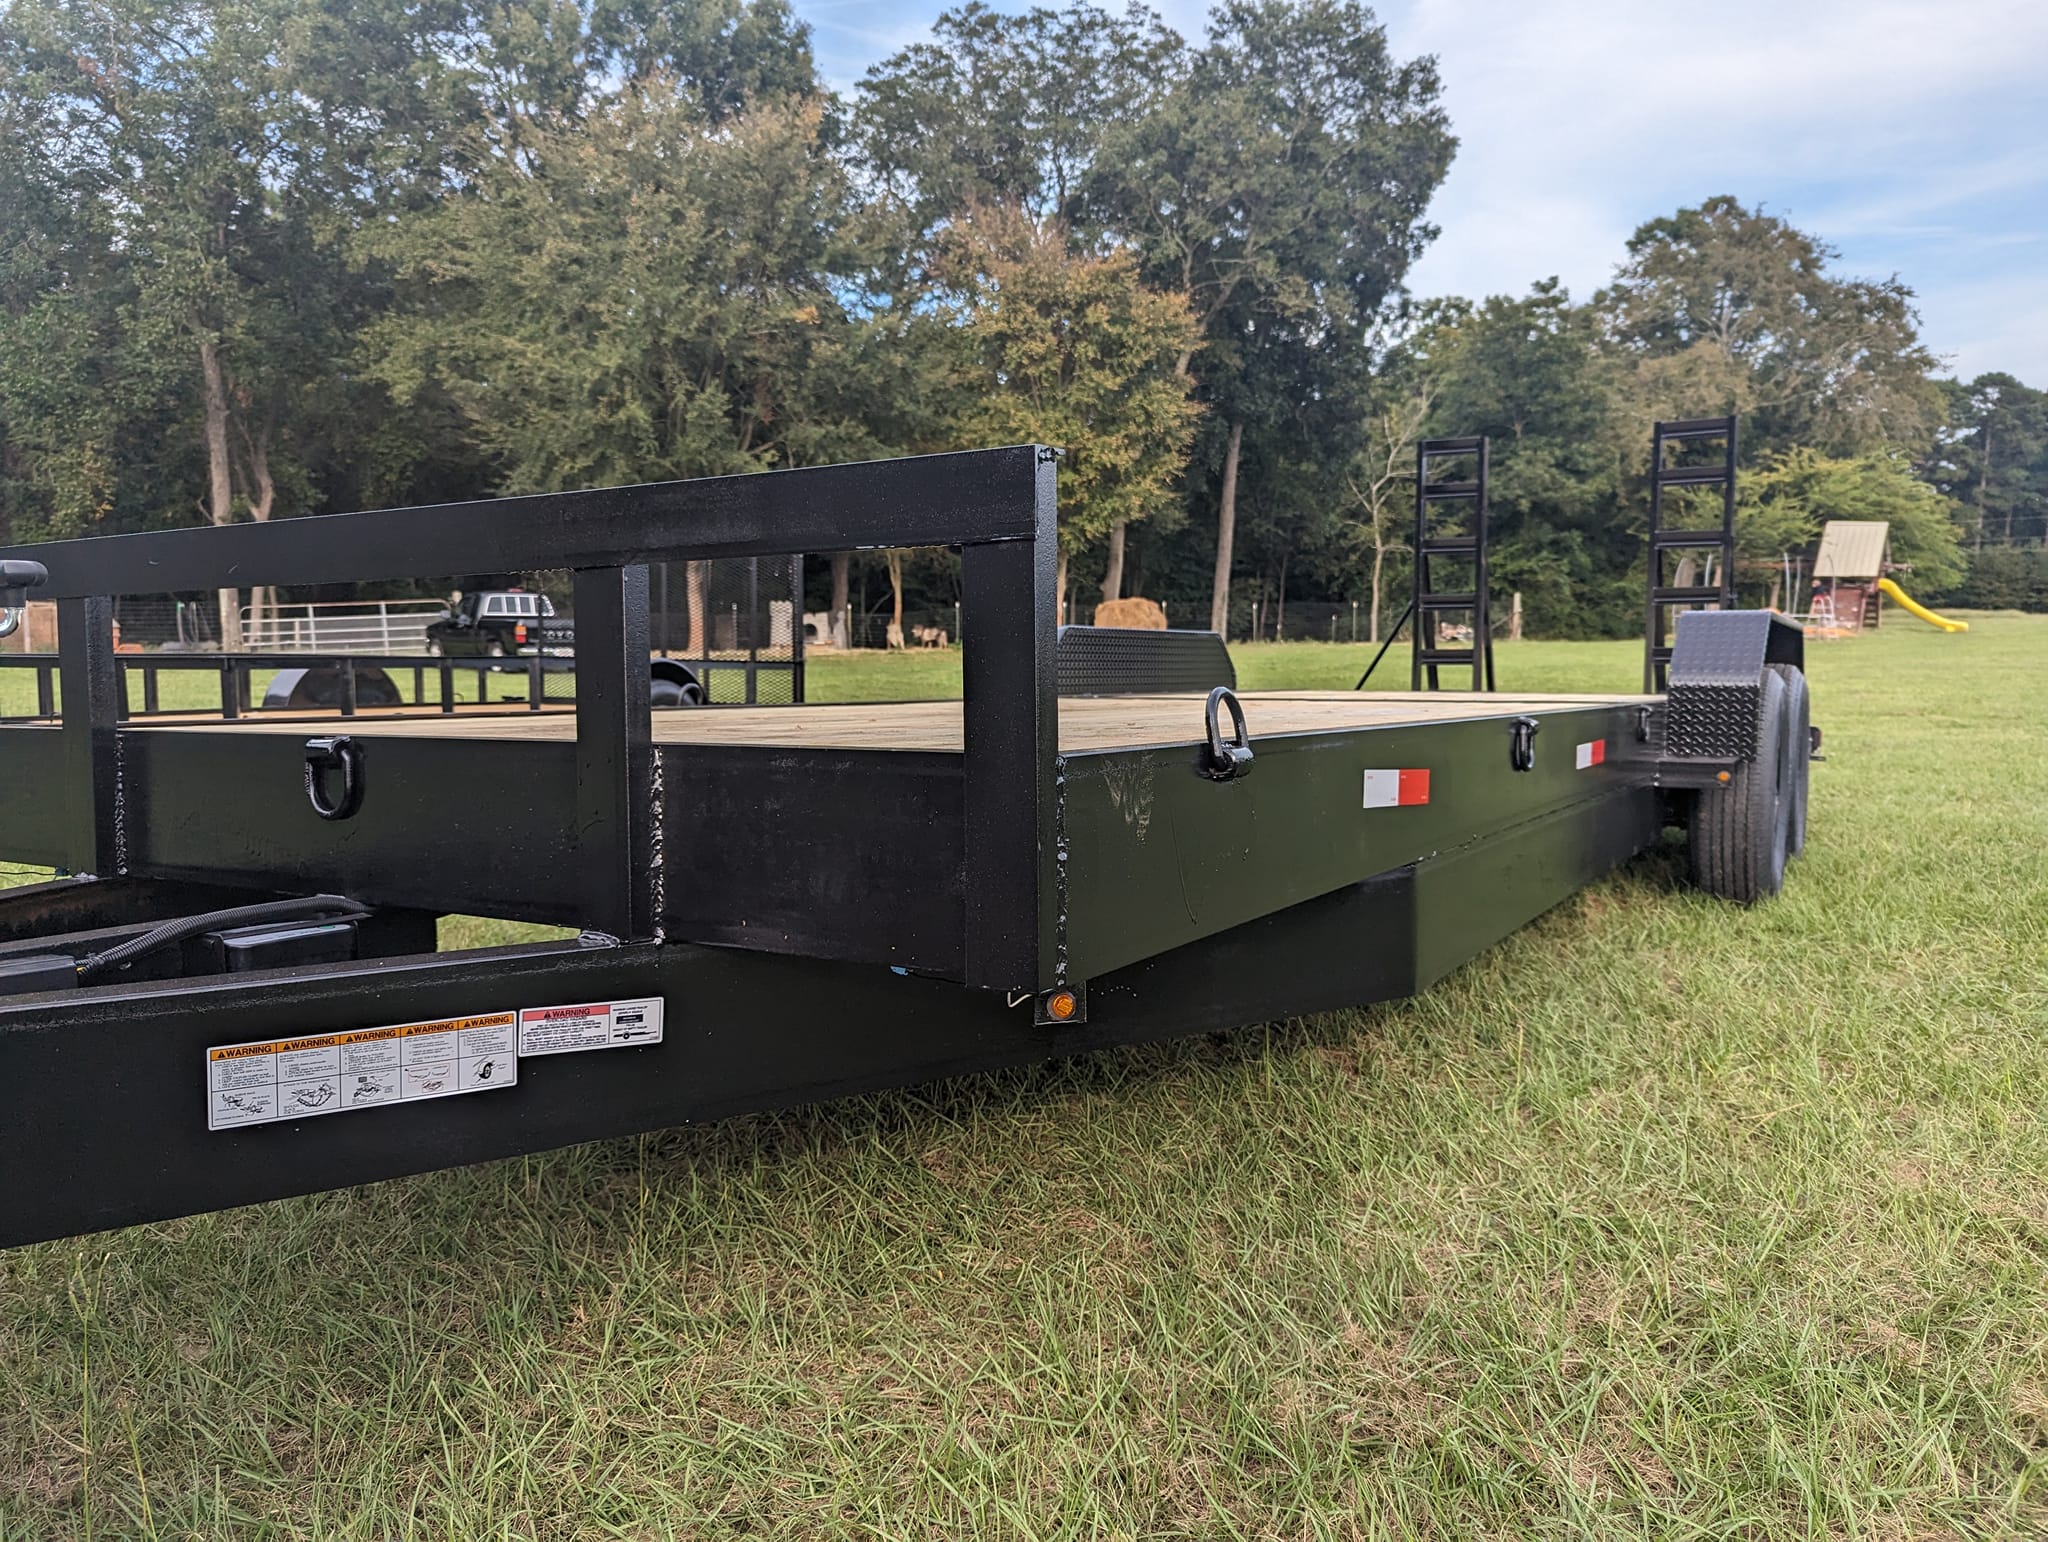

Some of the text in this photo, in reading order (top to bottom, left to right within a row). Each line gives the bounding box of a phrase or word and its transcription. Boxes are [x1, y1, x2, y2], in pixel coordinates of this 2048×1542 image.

[552, 1008, 591, 1018] WARNING
[471, 1015, 510, 1027] WARNING
[414, 1022, 455, 1034] WARNING
[354, 1030, 396, 1041] WARNING
[291, 1037, 336, 1049] WARNING
[226, 1046, 272, 1057] WARNING
